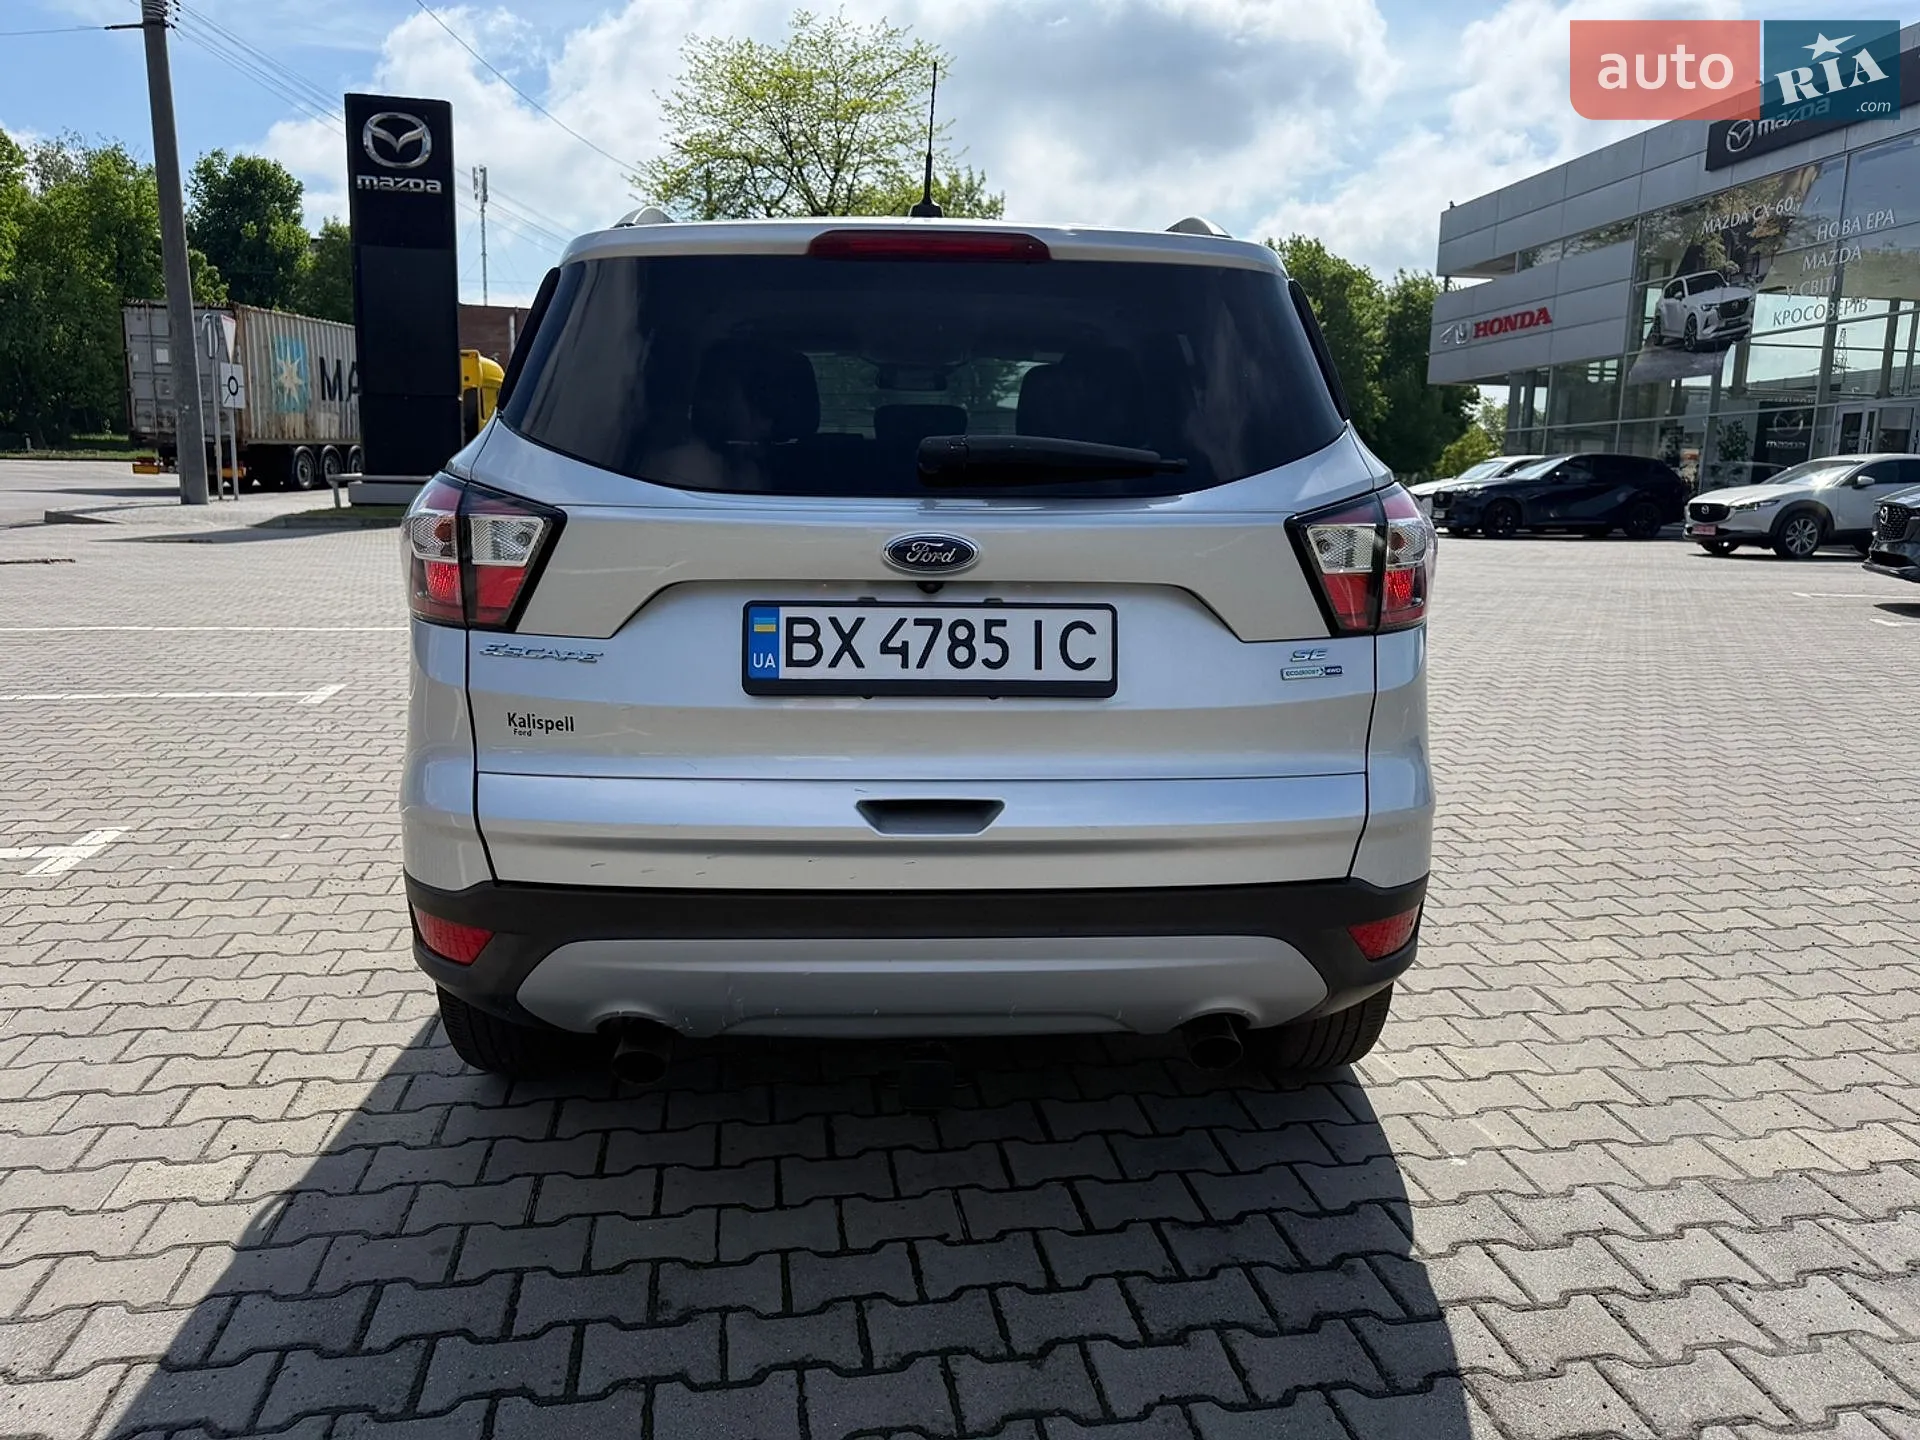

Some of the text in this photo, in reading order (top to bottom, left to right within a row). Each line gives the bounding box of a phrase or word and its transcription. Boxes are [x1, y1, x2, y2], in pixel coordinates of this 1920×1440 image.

[1701, 196, 1793, 235] MAZDA CX-60
[1817, 207, 1896, 241] НОВА ЕРА
[1802, 245, 1863, 272] MAZDA
[1473, 306, 1553, 338] HONDA
[906, 541, 956, 563] Ford
[480, 643, 604, 663] ESCAPE
[785, 616, 1097, 671] BX 4785 IC
[753, 652, 776, 669] UA
[1290, 649, 1328, 662] SE
[507, 712, 575, 735] Kalispell
[513, 728, 533, 737] Ford
